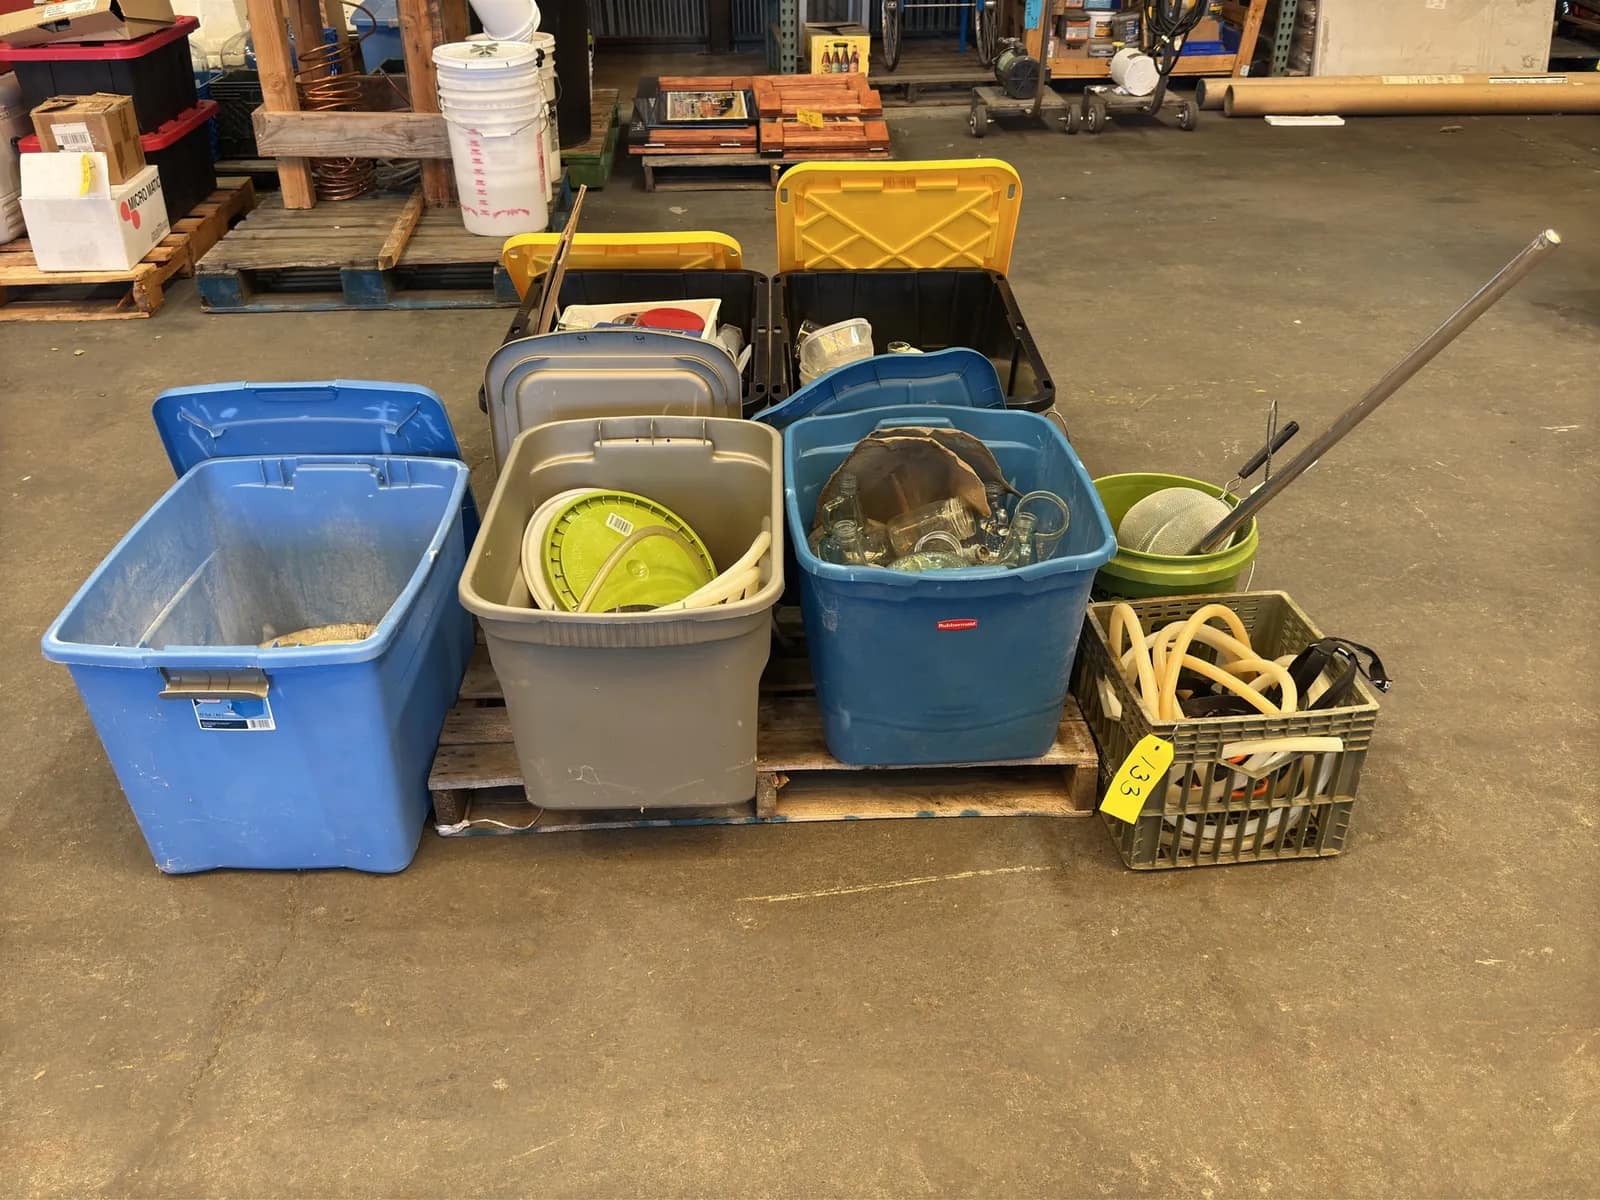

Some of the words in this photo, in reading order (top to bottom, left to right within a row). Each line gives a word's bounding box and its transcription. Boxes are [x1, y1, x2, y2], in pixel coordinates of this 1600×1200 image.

[127, 187, 148, 210] MICRO
[145, 175, 161, 197] MATIC
[938, 621, 976, 629] Rubbermaid
[1120, 756, 1156, 796] 133
